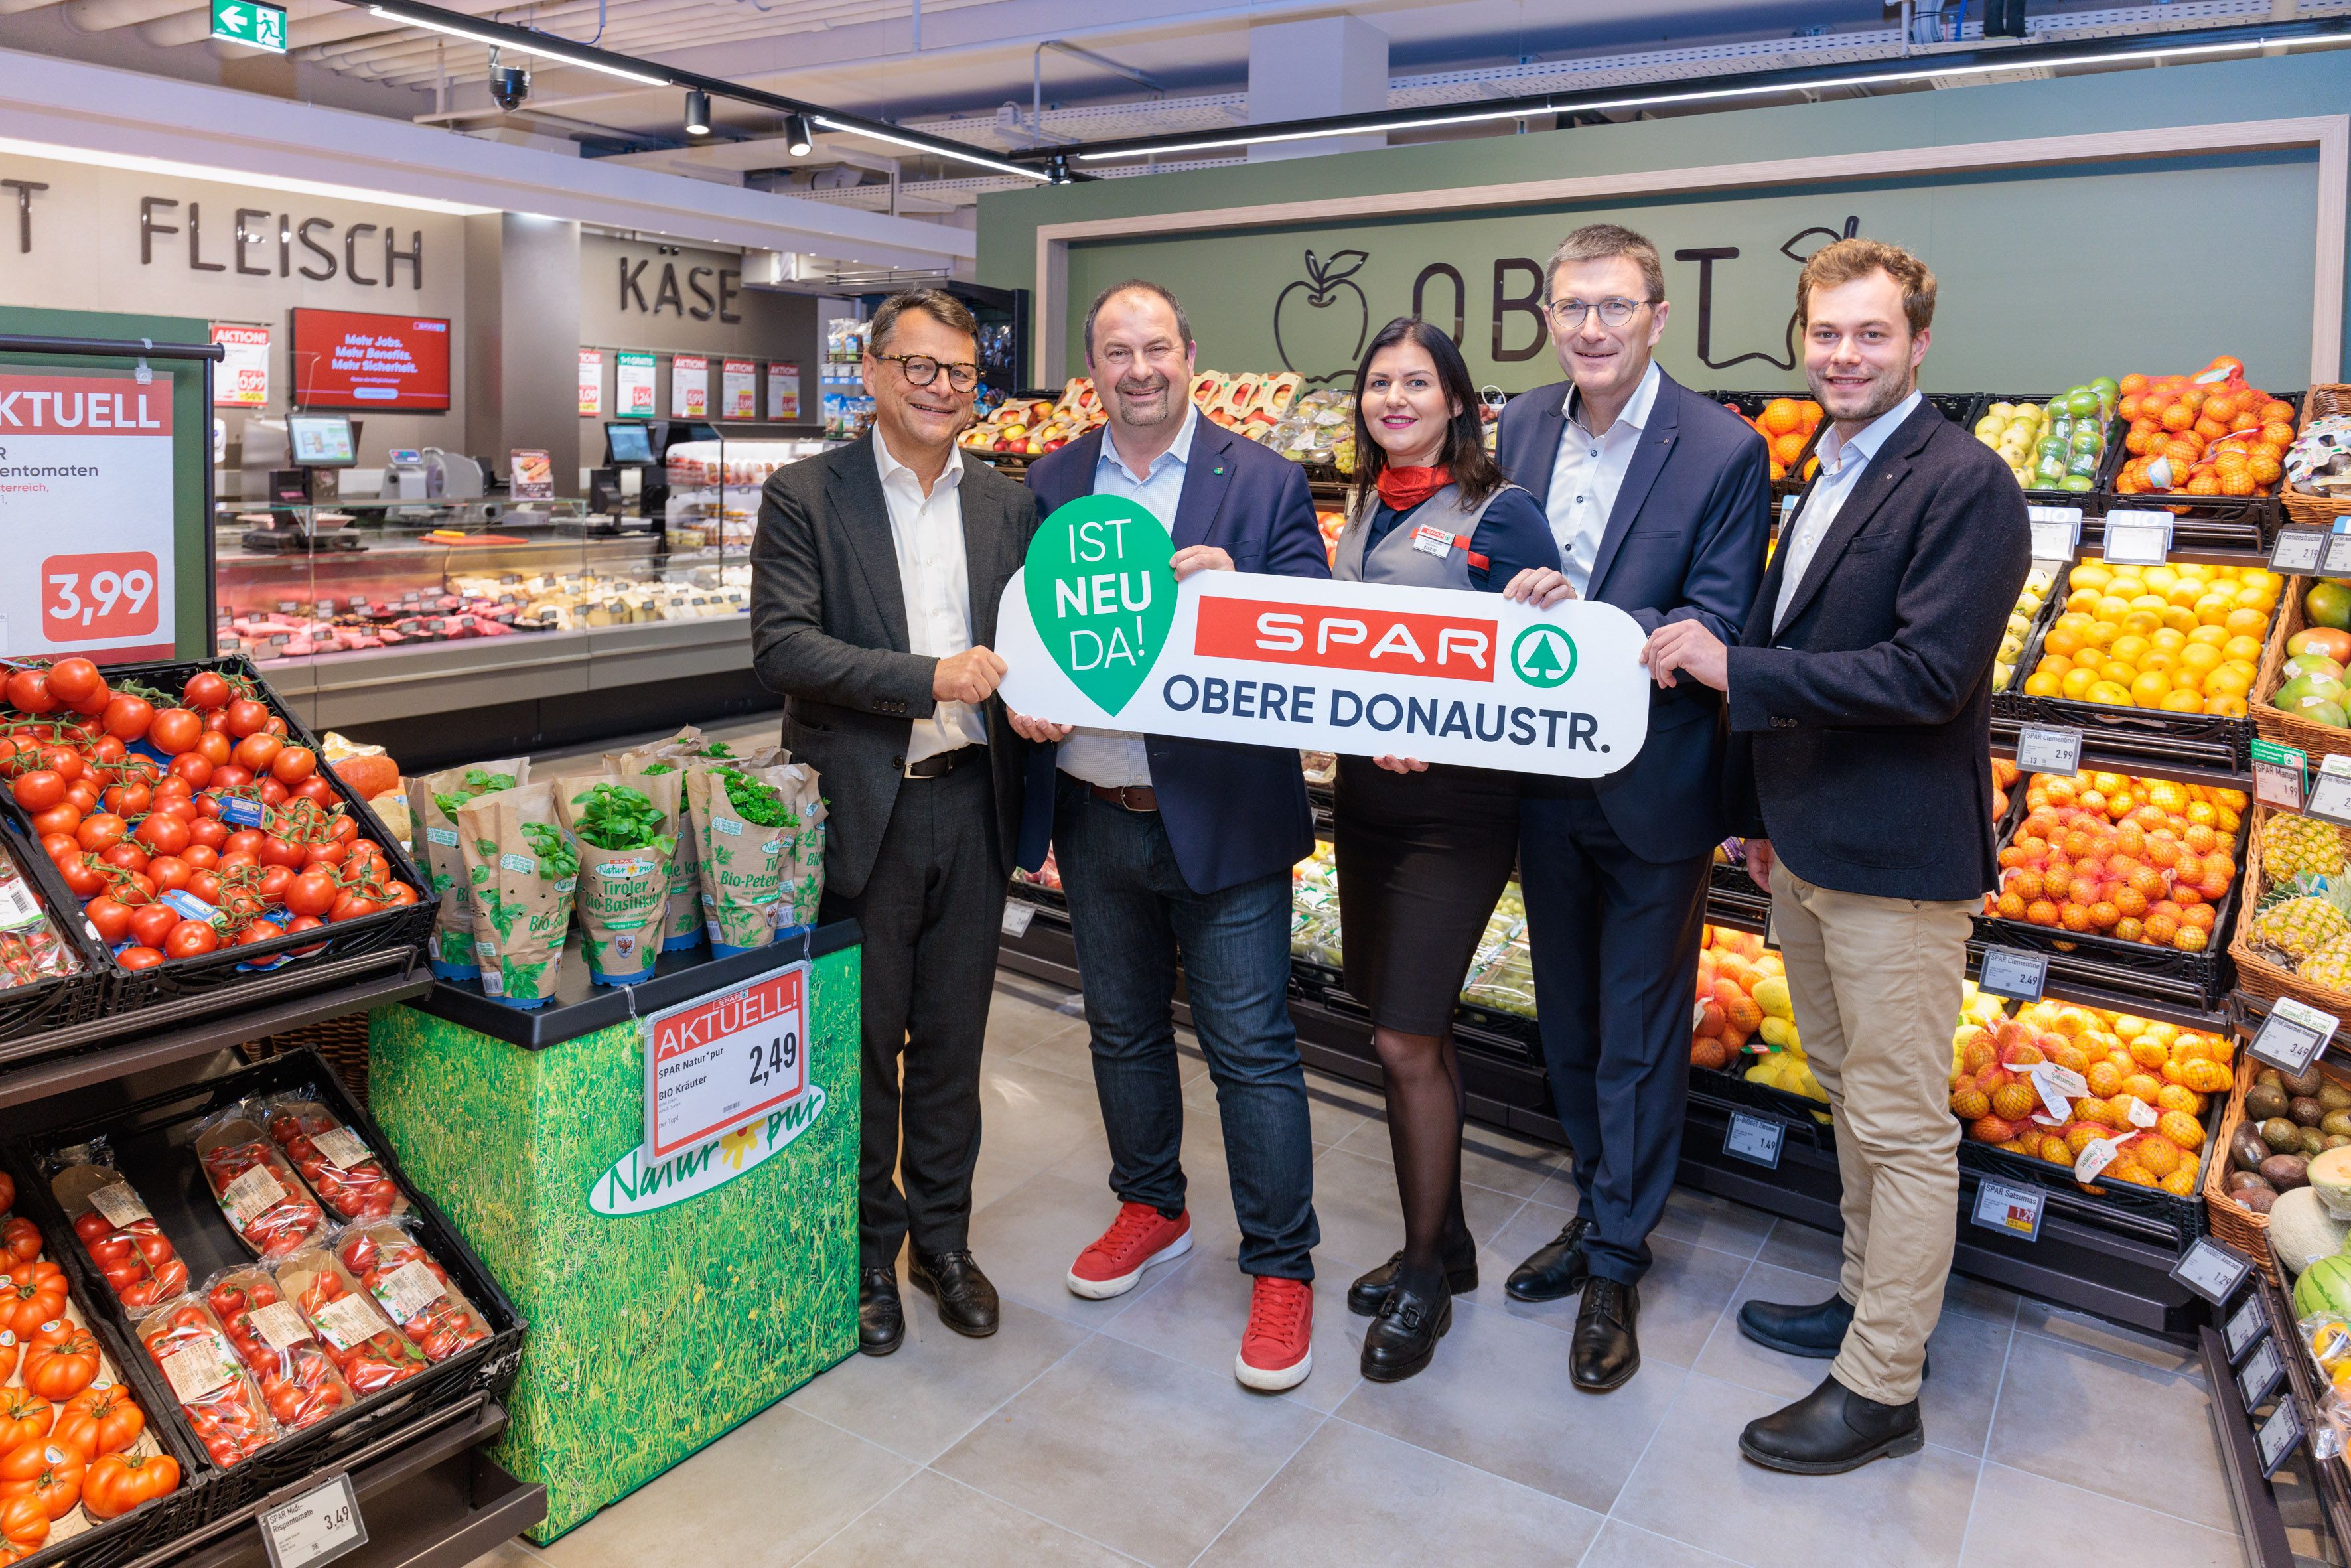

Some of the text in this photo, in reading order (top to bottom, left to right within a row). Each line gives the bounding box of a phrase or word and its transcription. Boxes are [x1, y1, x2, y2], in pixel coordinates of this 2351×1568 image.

[141, 196, 422, 290] FLEISCH
[620, 246, 741, 324] KÄSE
[1412, 247, 1740, 368] OBT
[214, 329, 267, 344] AKTION!
[345, 334, 403, 348] Mehr Jobs.
[336, 346, 412, 360] Mehr Benefits.
[332, 358, 418, 373] Mehr Sicherheit.
[675, 358, 707, 369] AKTION!
[725, 363, 754, 373] AKTION!
[770, 366, 797, 376] AKTION!
[239, 376, 265, 390] 0,99
[0, 464, 99, 477] entomaten
[2031, 508, 2070, 522] BIO
[2120, 512, 2161, 526] BIO
[1068, 518, 1132, 564] IST
[1426, 529, 1445, 538] SPAR
[2283, 533, 2322, 542] Passionsfrüchte
[2303, 549, 2318, 559] 2.19
[49, 569, 153, 626] 3,99
[1055, 570, 1151, 618] NEU
[1070, 614, 1145, 672] DA!
[1255, 612, 1488, 670] SPAR
[1163, 673, 1612, 754] OBERE DONAUSTR.
[2043, 735, 2075, 744] Clementine
[2055, 749, 2073, 760] 2.99
[2257, 763, 2297, 783] SPAR Mango
[2284, 785, 2298, 797] 1.99
[512, 864, 531, 874] MATERI
[599, 863, 654, 875] Natur pur
[603, 880, 648, 896] Tiroler
[1991, 954, 2040, 969] SPAR Clementine
[2020, 973, 2038, 985] 2.49
[719, 995, 740, 1007] SPAR
[657, 981, 797, 1060] AKTUELL!
[2272, 1017, 2284, 1027] SPAR
[2284, 1021, 2302, 1033] Gourmet
[2290, 1043, 2309, 1058] 3.49
[750, 1032, 796, 1086] 2,49
[659, 1064, 680, 1079] SPAR
[659, 1074, 707, 1101] BIO Kräuter
[2051, 1071, 2076, 1089] Satsumas
[658, 1114, 679, 1130] per Topf
[1735, 1115, 1777, 1133] S-BUDGET Zitronen
[608, 1094, 822, 1209] Natur pur
[1760, 1138, 1776, 1150] 1.49
[1985, 1184, 2003, 1195] SPAR
[2005, 1190, 2037, 1205] Satsumas
[2016, 1208, 2035, 1222] 1.29
[2198, 1244, 2241, 1271] S-BUDGET Avocado
[2214, 1271, 2232, 1286] 1.29
[269, 1503, 303, 1524] SPAR Midi-
[272, 1508, 314, 1533] Rispentomate
[324, 1506, 349, 1530] 3.49
